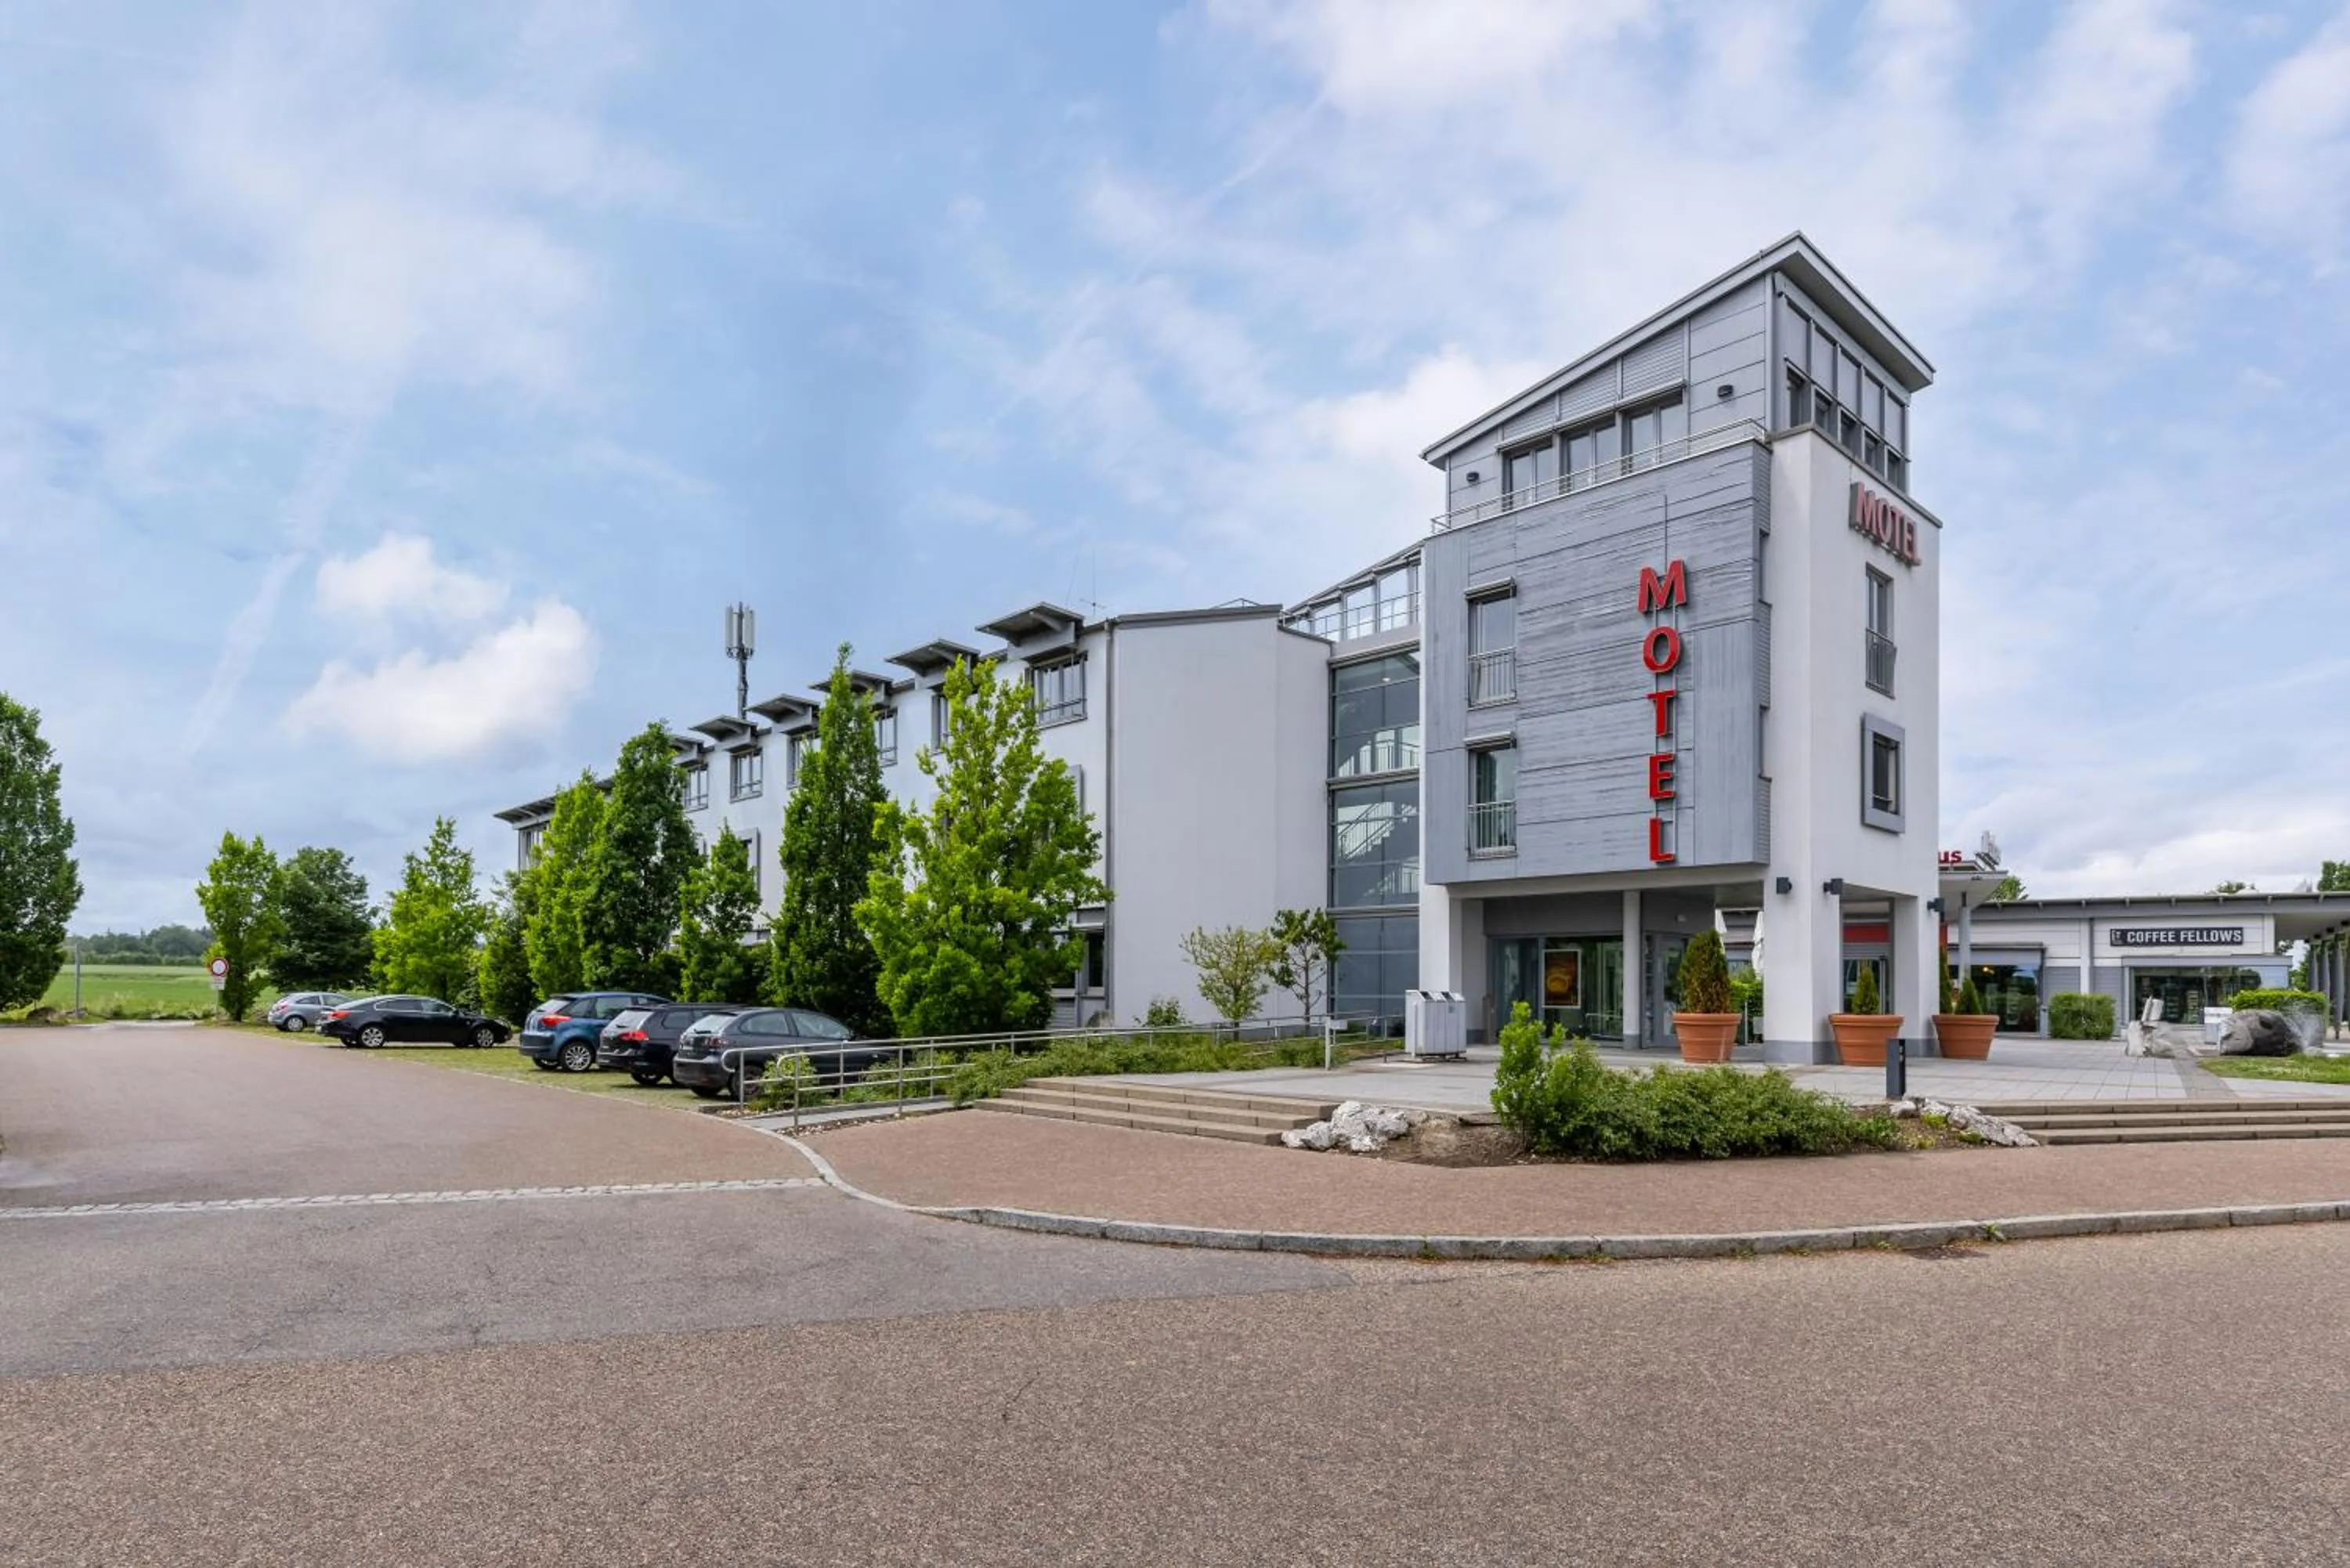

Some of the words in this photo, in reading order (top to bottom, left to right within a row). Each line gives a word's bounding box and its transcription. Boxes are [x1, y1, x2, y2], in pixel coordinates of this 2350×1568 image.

[1852, 481, 1922, 565] MOTEL
[1637, 558, 1687, 862] MOTEL
[2127, 930, 2176, 943] COFFEE
[2180, 930, 2242, 943] FELLOWS
